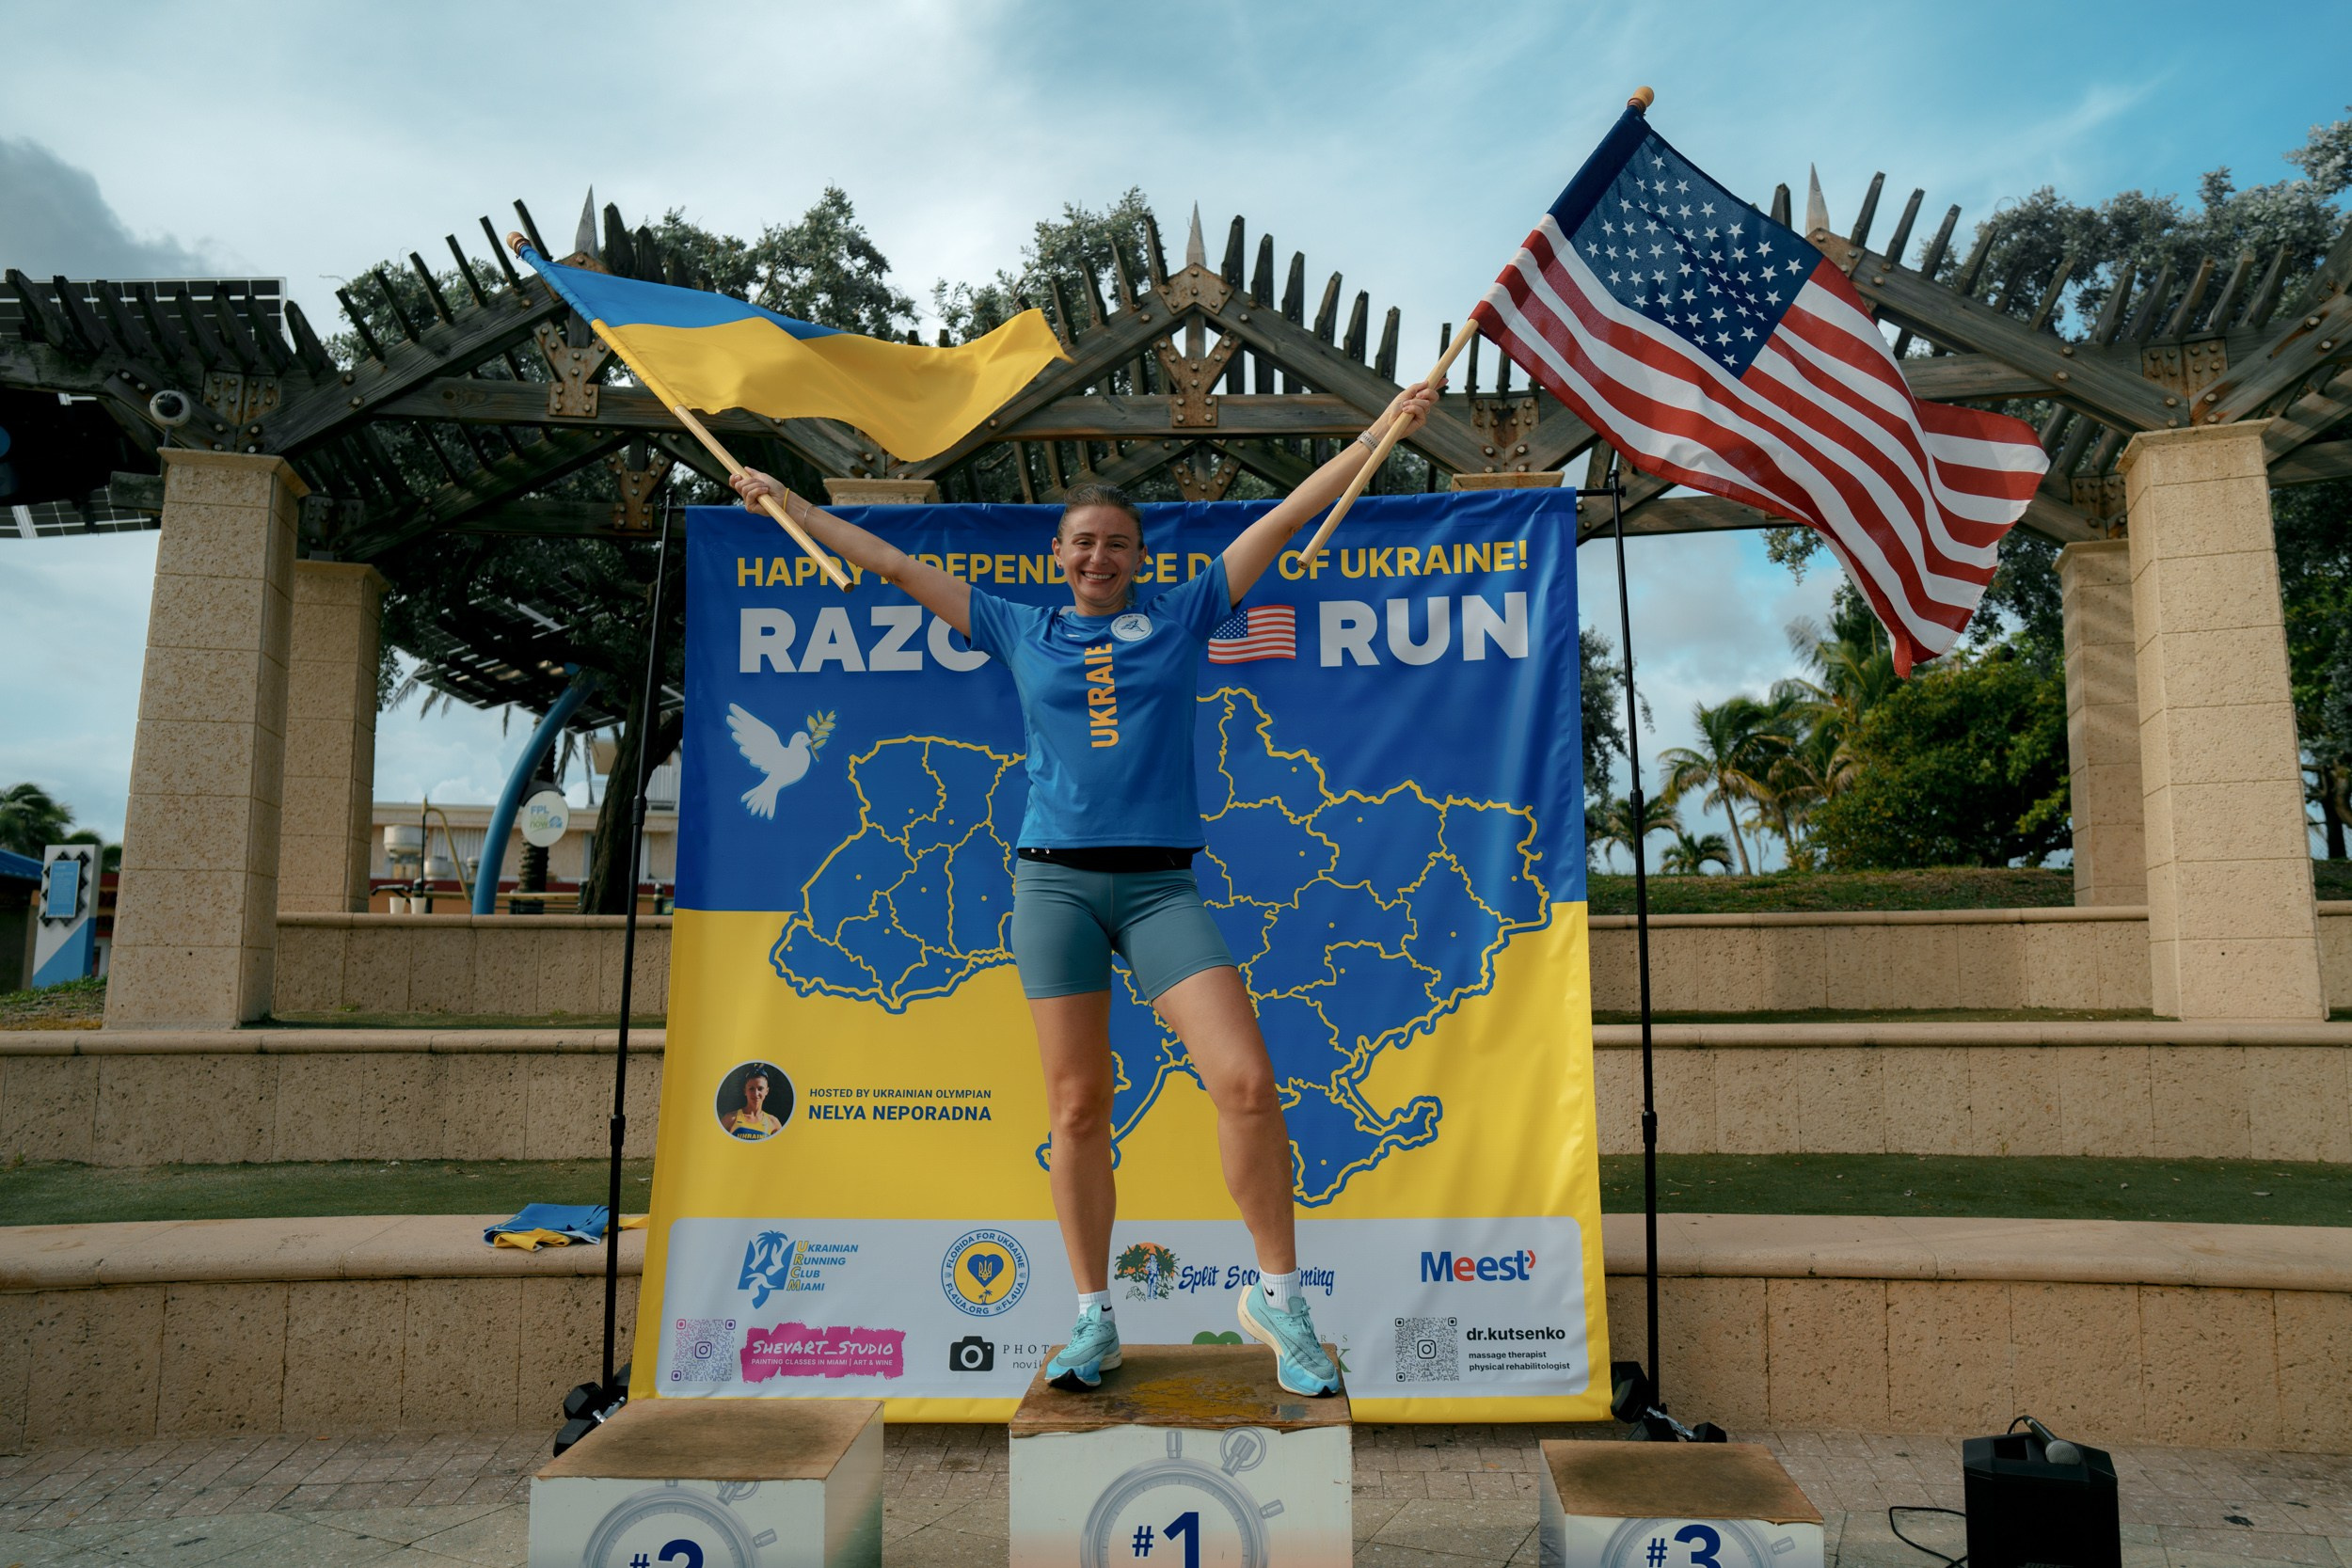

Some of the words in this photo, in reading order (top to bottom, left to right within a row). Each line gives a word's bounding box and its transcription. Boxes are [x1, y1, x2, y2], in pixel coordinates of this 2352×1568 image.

[1279, 549, 1330, 580] OF
[1341, 540, 1528, 578] UKRAINE!
[1319, 592, 1529, 668] RUN
[809, 1088, 852, 1099] HOSTED
[856, 1088, 869, 1098] BY
[873, 1088, 932, 1099] UKRAINIAN
[936, 1089, 992, 1099] OLYMPIAN
[808, 1105, 866, 1119] NELYA
[872, 1106, 992, 1120] NEPORADNA
[797, 1241, 859, 1253] UKRAINIAN
[946, 1236, 975, 1269] FLORIDA
[997, 1235, 1025, 1269] UKRAINE
[793, 1254, 846, 1265] RUNNING
[1421, 1250, 1531, 1283] Meest
[790, 1266, 820, 1278] CLUB
[1178, 1265, 1219, 1293] Split
[787, 1279, 825, 1291] MIAMI
[946, 1282, 990, 1314] FL4UA.ORG
[995, 1282, 1025, 1311] @FL4UA
[1466, 1327, 1566, 1341] dr.kutsenko
[1469, 1351, 1506, 1361] massage
[1508, 1350, 1548, 1360] therapist
[1469, 1363, 1504, 1372] physical
[1506, 1362, 1570, 1371] rehabilitologist
[1131, 1512, 1200, 1568] #1
[1645, 1524, 1722, 1568] #3
